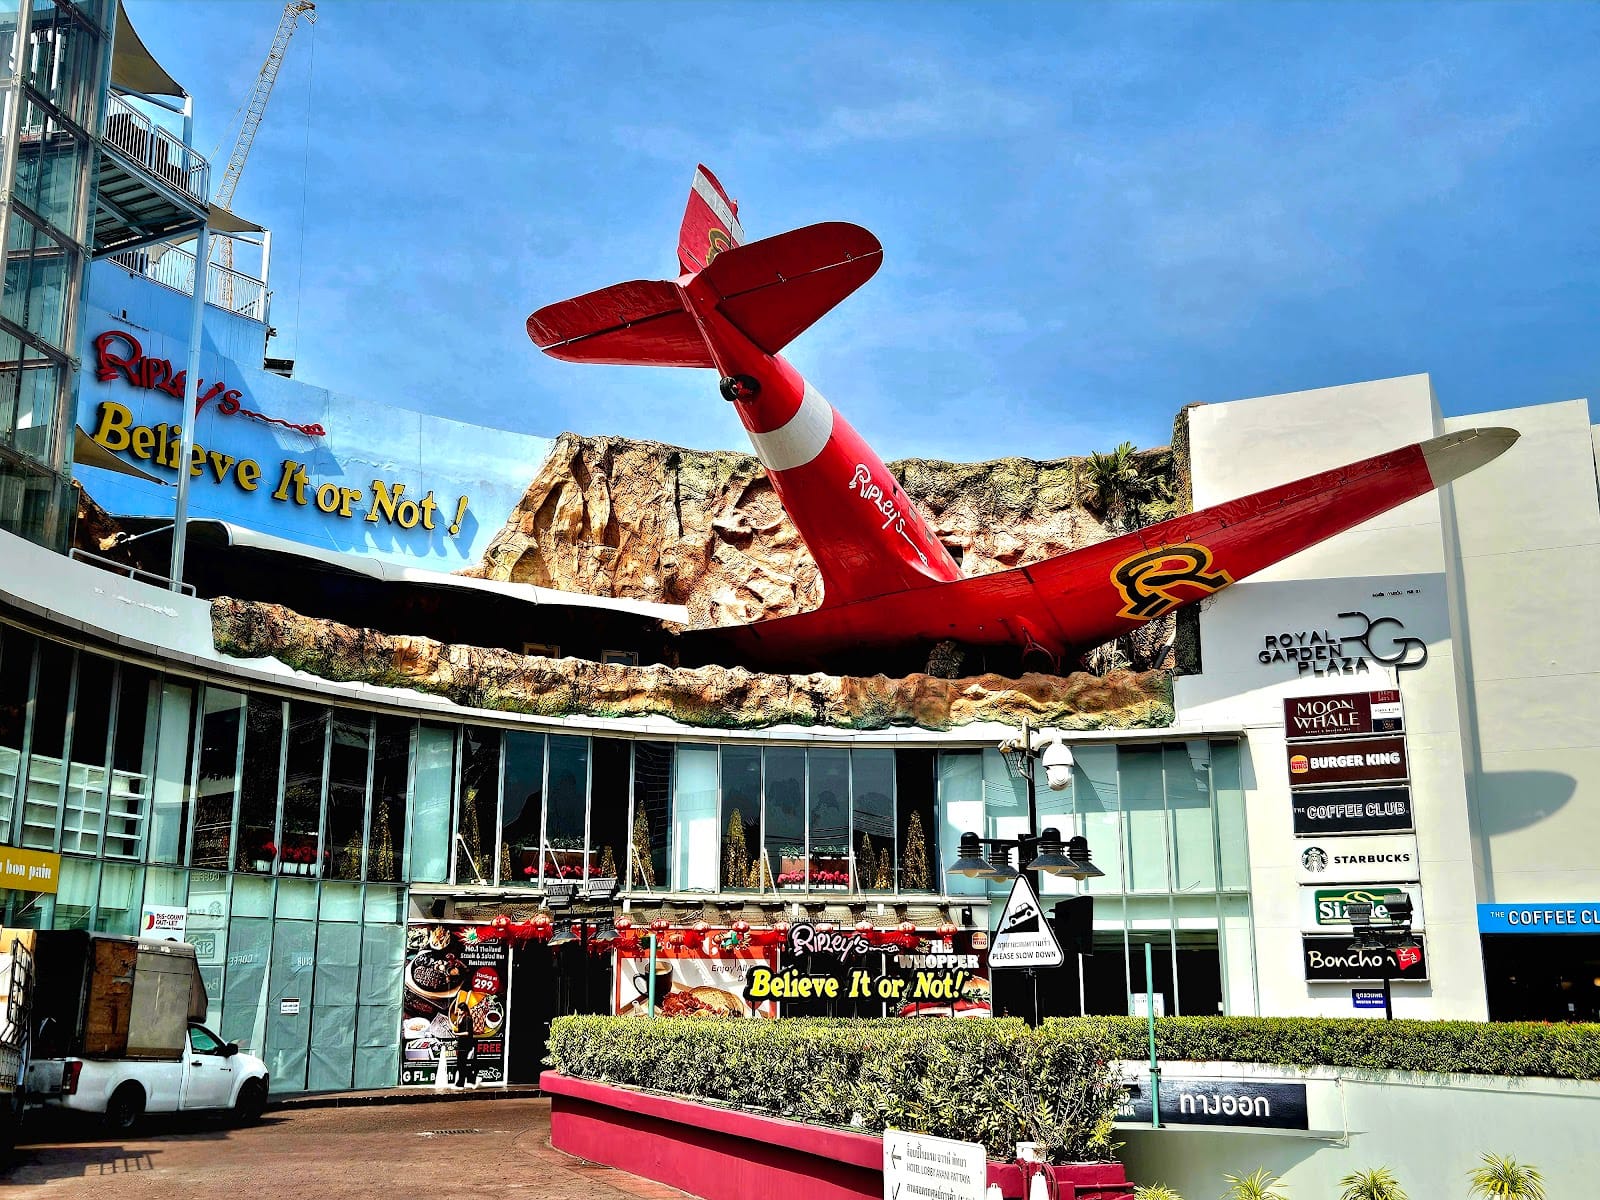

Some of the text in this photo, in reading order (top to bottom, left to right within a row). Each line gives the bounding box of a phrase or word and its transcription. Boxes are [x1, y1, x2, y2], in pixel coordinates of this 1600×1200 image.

[95, 401, 261, 491] Believe
[273, 460, 309, 506] It
[316, 482, 362, 518] or
[366, 479, 437, 530] Not
[1265, 630, 1335, 649] ROYAL
[1258, 644, 1343, 664] GARDEN
[1297, 657, 1370, 675] PLAZA
[1297, 699, 1354, 716] MOON
[1293, 711, 1361, 730] WHALE
[1310, 752, 1400, 769] BURGER KING
[1307, 803, 1363, 820] COFFEE
[1366, 801, 1406, 817] CLUB
[1334, 853, 1410, 864] STARBUCKS
[28, 863, 51, 881] pain
[1508, 910, 1577, 925] COFFEE
[992, 951, 1056, 960] PLEASE SLOW DOWN
[749, 969, 965, 998] Believe It or Not!
[477, 1043, 502, 1053] FREE
[1179, 1093, 1271, 1116] ทางออก
[907, 1163, 921, 1174] HOTEL
[951, 1172, 971, 1184] PATTAYA
